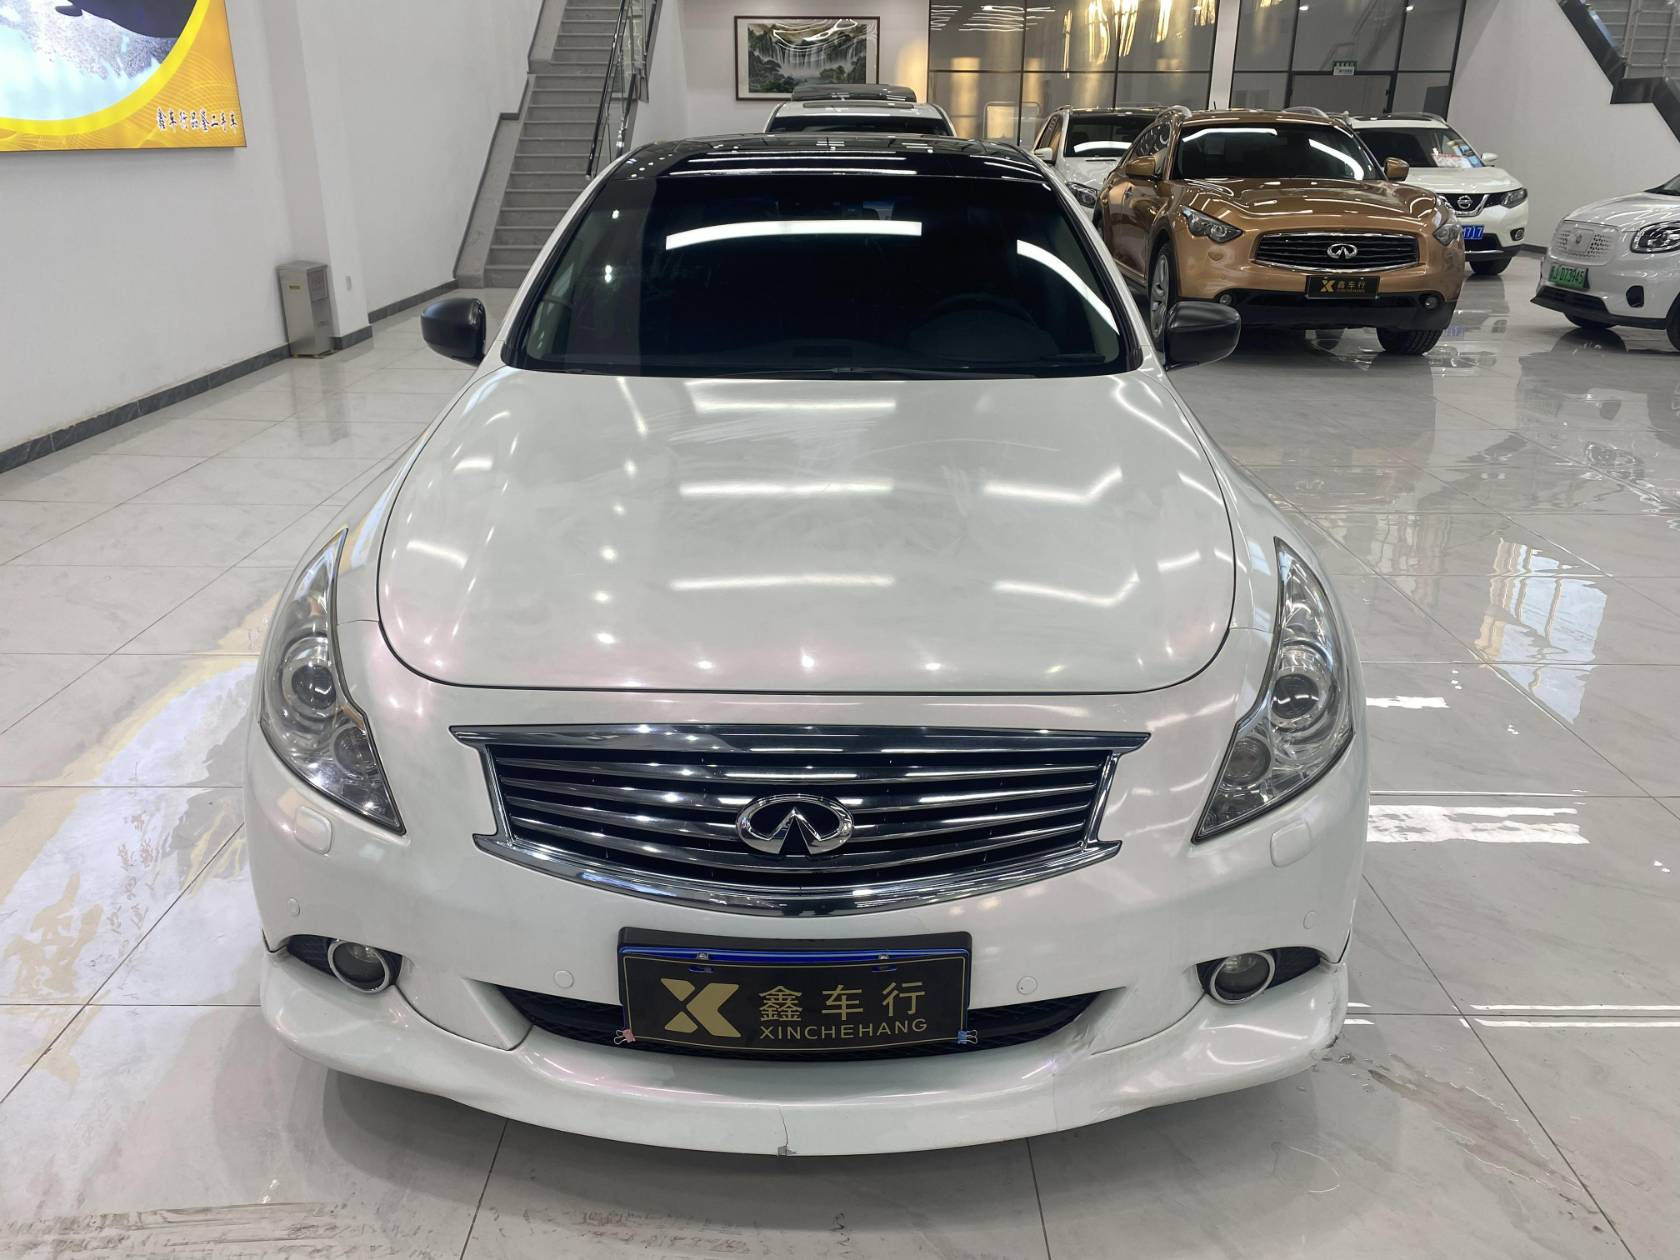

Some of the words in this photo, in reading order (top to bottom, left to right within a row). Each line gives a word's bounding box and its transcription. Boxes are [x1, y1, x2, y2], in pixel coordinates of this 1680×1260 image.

[758, 981, 926, 1022] 鑫车行
[759, 1017, 928, 1040] XINCHEHANG
